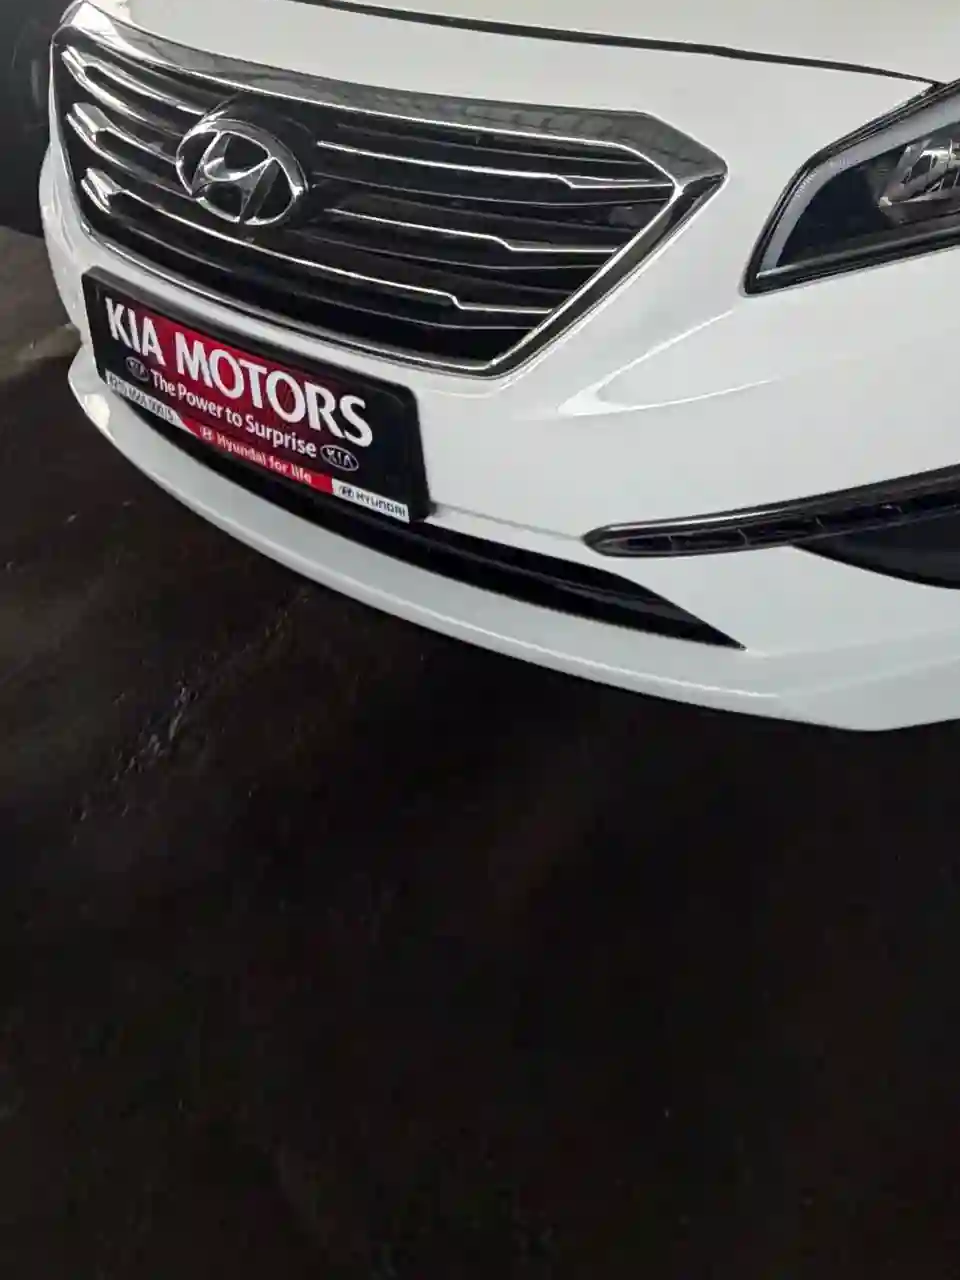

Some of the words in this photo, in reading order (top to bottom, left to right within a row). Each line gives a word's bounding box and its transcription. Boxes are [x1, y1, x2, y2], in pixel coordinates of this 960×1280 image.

[104, 297, 164, 366] KIA
[175, 332, 373, 448] MOTORS
[151, 369, 176, 397] The
[178, 382, 224, 419] Power
[225, 406, 242, 428] to
[245, 413, 317, 458] Surprise
[268, 455, 288, 472] for
